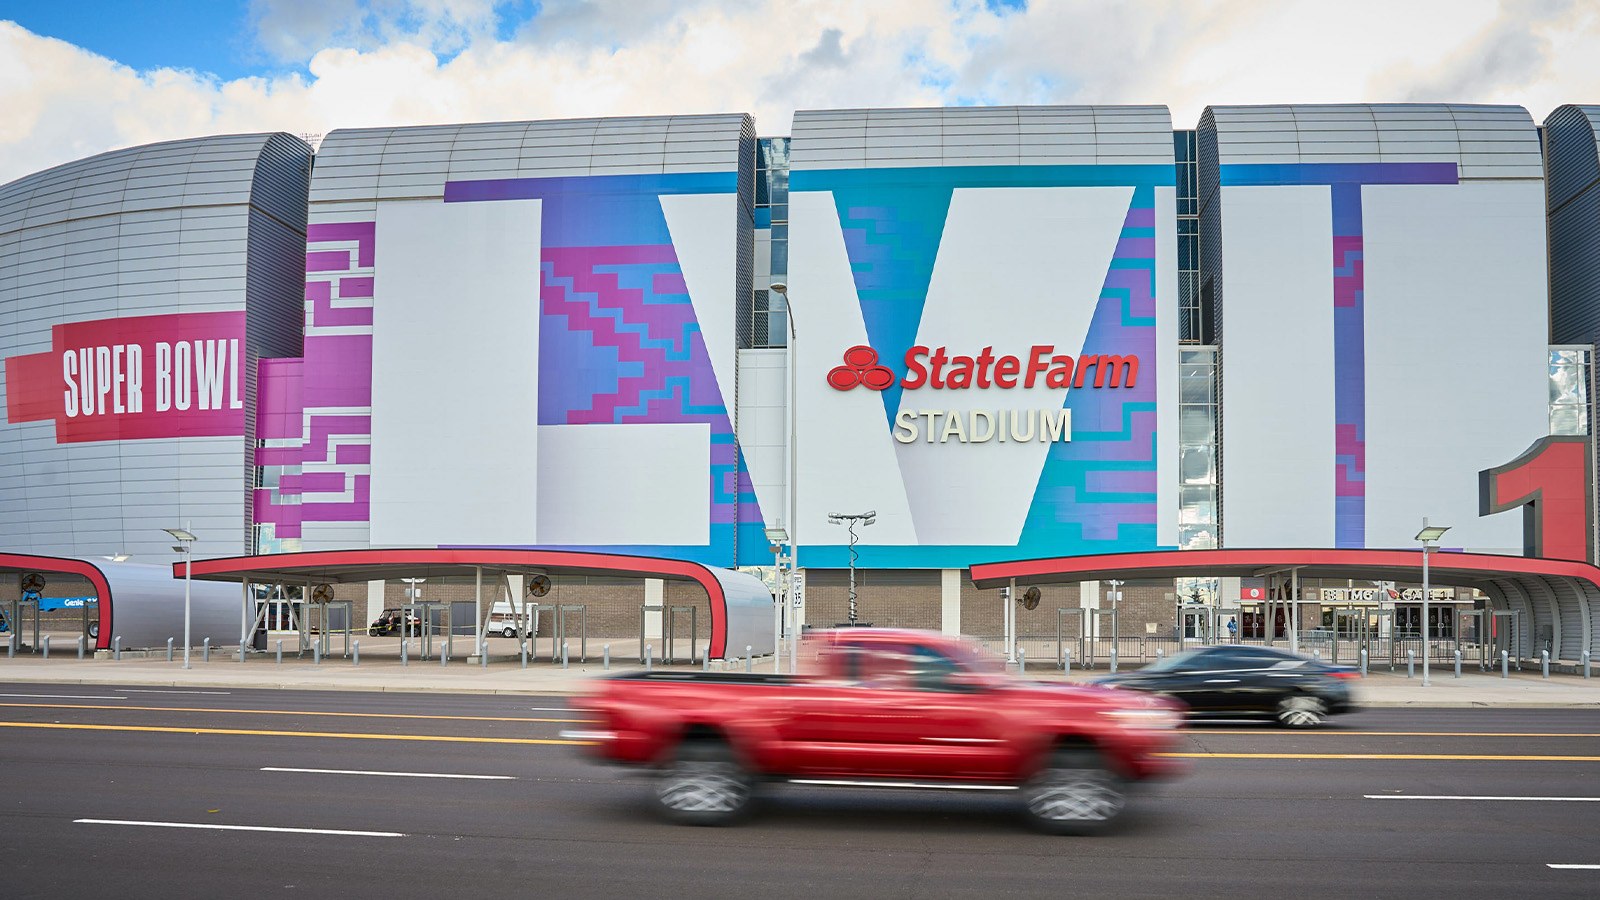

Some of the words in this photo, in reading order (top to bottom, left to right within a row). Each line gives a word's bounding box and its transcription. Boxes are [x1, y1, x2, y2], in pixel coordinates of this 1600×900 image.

[63, 343, 143, 418] SUPER
[155, 338, 243, 412] BOWL
[901, 345, 1021, 390] State
[1025, 345, 1140, 389] Farm
[895, 408, 1072, 443] STADIUM
[1479, 434, 1595, 562] 1
